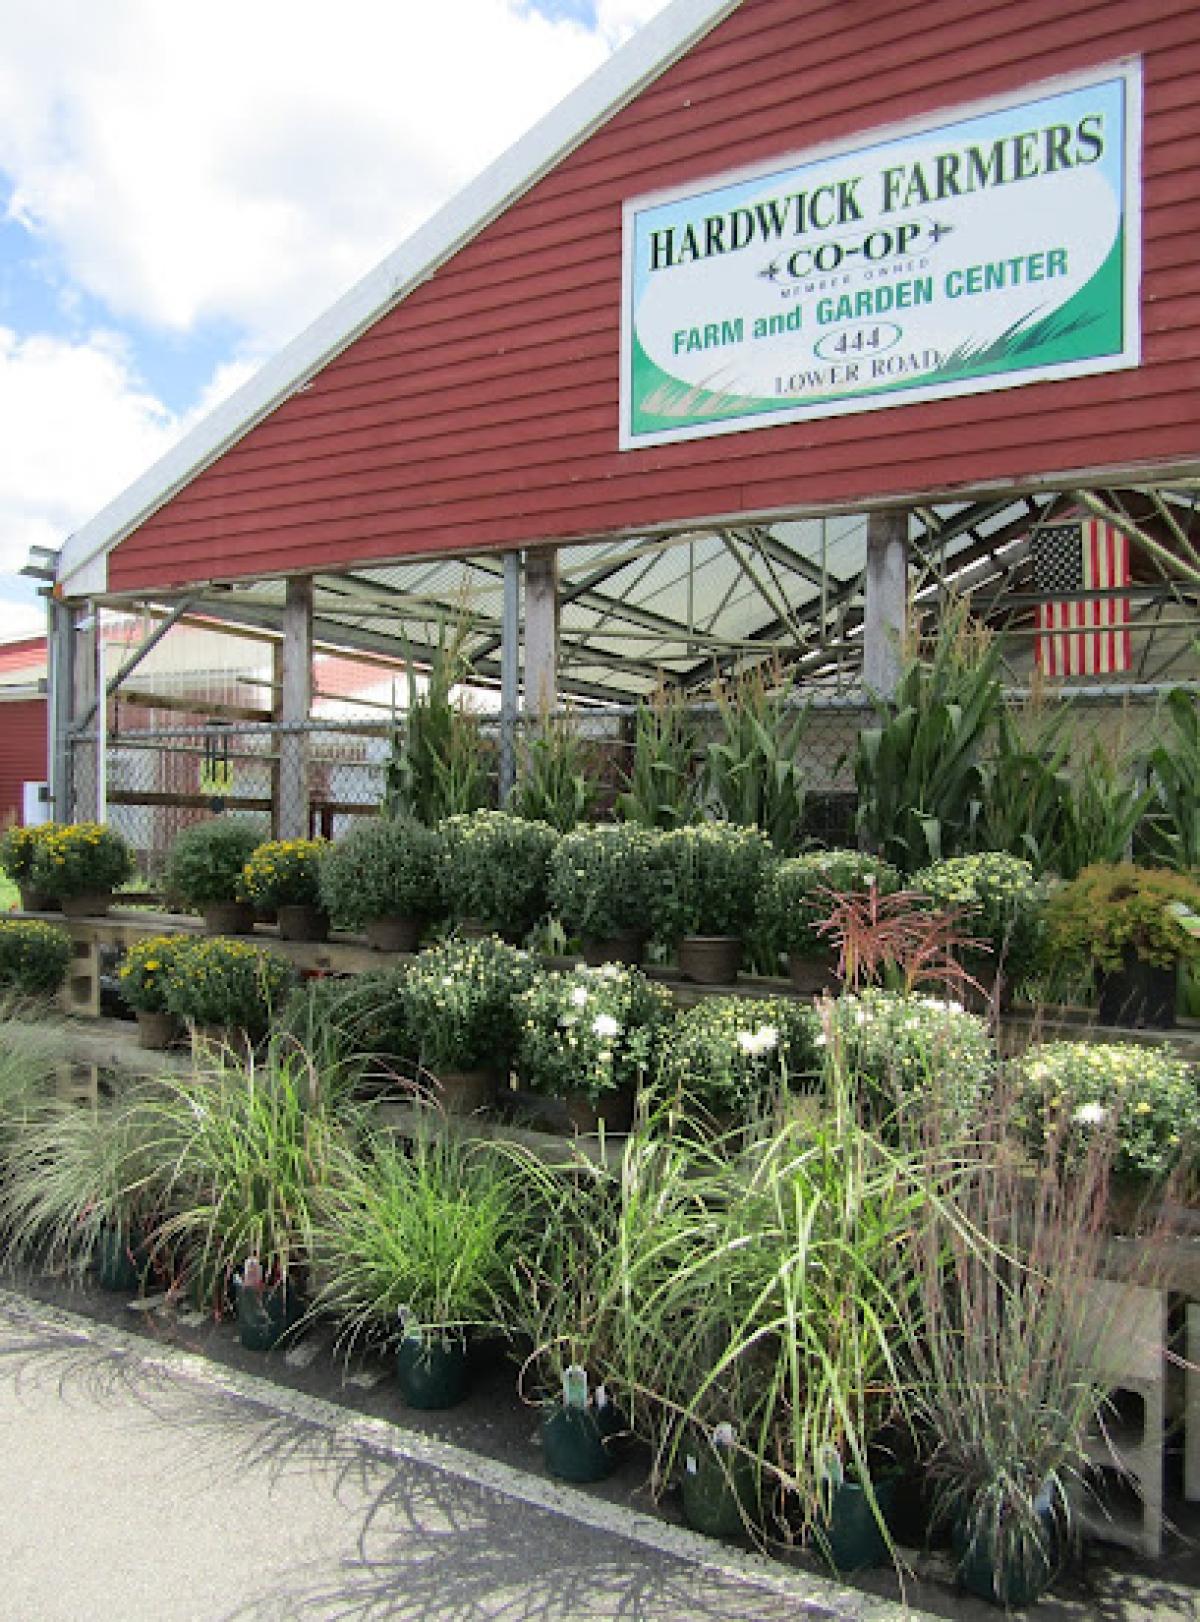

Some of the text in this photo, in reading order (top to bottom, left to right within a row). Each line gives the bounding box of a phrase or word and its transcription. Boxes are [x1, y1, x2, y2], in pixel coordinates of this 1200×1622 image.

[649, 114, 1104, 272] HARDWICK FARMERS
[787, 224, 921, 278] CO-OP
[673, 248, 1068, 355] FARM and GARDEN CENTER
[833, 326, 880, 354] 444
[774, 350, 940, 395] LOWER ROAD
